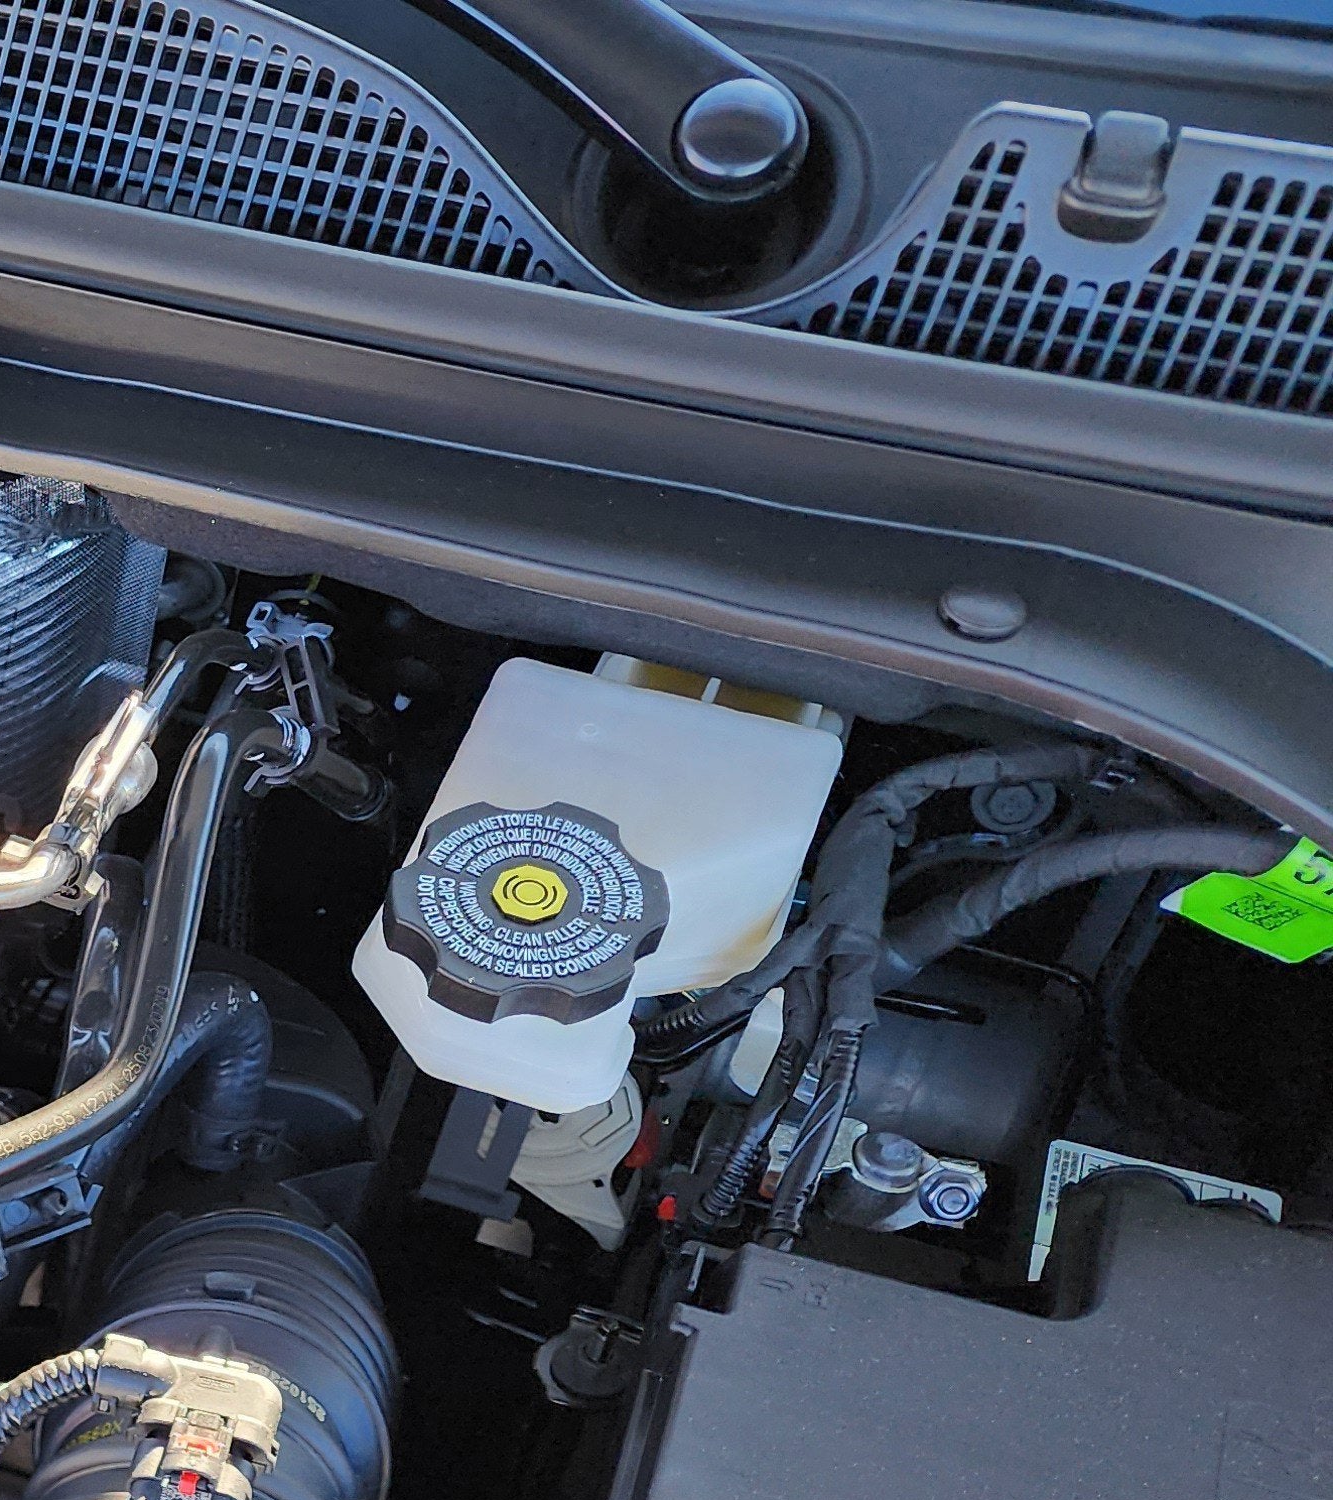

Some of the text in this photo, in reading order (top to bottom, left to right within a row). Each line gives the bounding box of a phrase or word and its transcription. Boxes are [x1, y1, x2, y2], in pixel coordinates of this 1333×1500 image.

[505, 828, 532, 842] QUE
[545, 815, 564, 830] LE
[465, 842, 532, 877] PROVENANT
[438, 878, 456, 901] CAP
[440, 899, 480, 942] BEFORE
[494, 927, 543, 947] CLEAN
[544, 917, 591, 945] FILLER
[420, 904, 453, 938] FLUID
[442, 934, 484, 965] FROM
[494, 959, 553, 978] SEALED
[575, 924, 609, 952] ONLY
